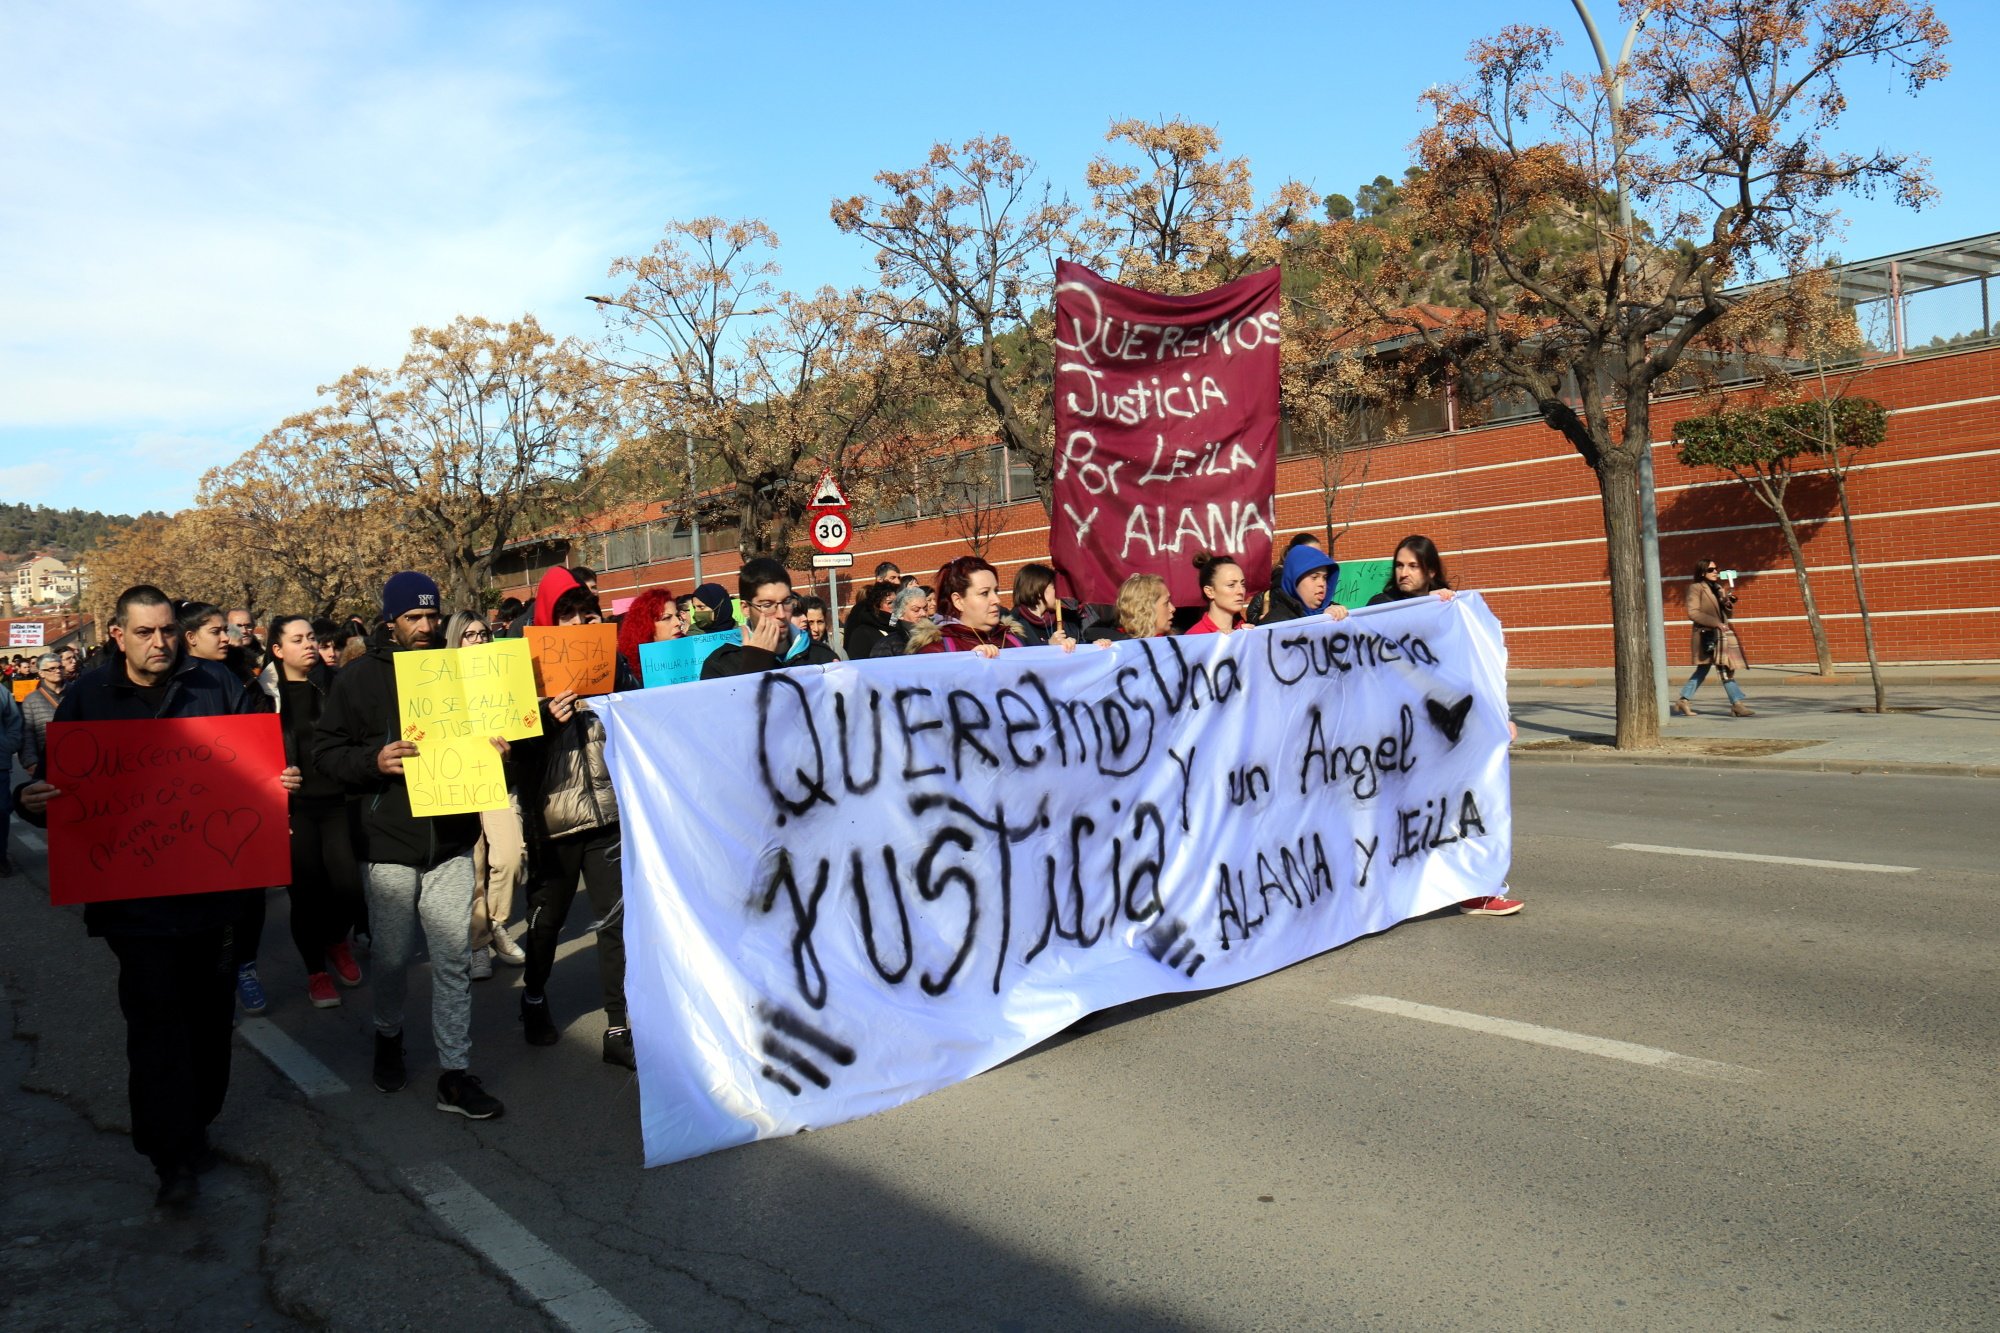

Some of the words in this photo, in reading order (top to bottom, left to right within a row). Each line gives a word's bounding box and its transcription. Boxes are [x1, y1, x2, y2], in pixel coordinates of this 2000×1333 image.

[1056, 281, 1280, 364] QUEREMOS
[1057, 431, 1124, 495] Por
[818, 524, 843, 539] 30
[1063, 503, 1098, 546] Y
[418, 594, 435, 606] NY
[539, 636, 608, 664] BASTA
[416, 653, 519, 686] SALLENT
[565, 665, 592, 690] YA
[1140, 636, 1241, 715] Una
[1267, 629, 1439, 685] Guerrera
[408, 697, 433, 719] NO
[440, 696, 462, 714] SE
[467, 691, 516, 712] CALLA
[417, 747, 463, 782] NO
[472, 759, 488, 776] +
[1168, 746, 1196, 831] Y
[1228, 765, 1270, 806] un
[1300, 704, 1417, 800] Angel
[413, 782, 506, 807] SILENCIO
[1217, 832, 1333, 950] ALANA
[1355, 836, 1379, 887] Y
